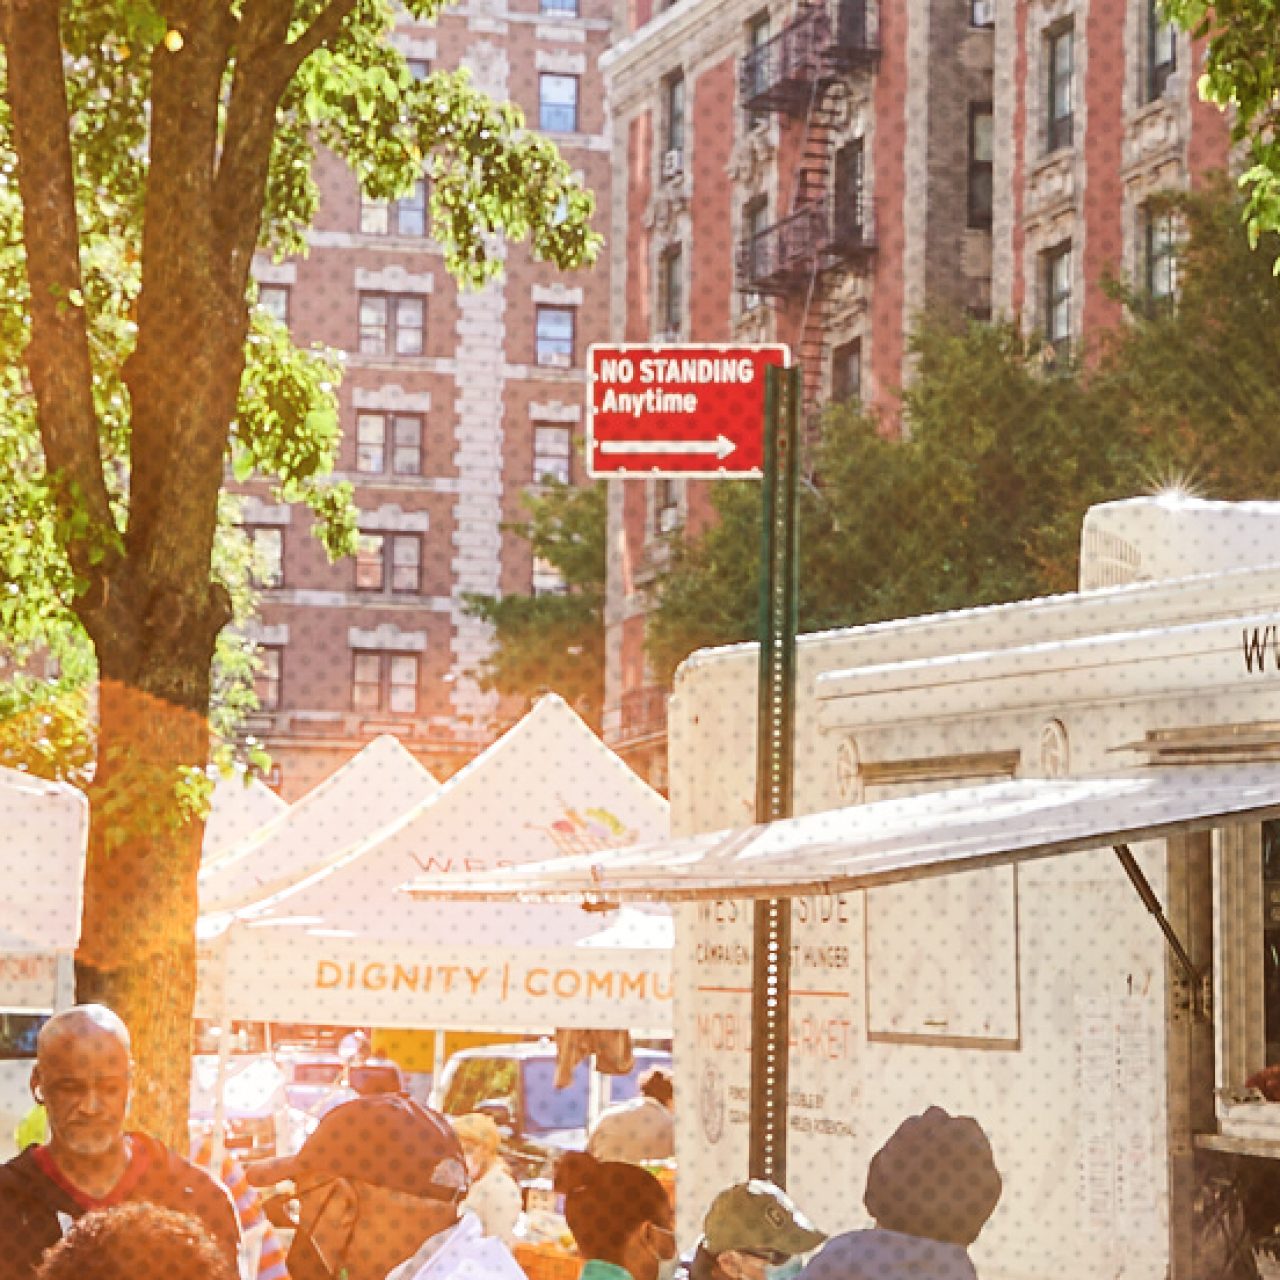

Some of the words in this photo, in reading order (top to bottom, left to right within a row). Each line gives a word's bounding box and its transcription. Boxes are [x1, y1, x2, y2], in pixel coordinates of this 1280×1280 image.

[601, 358, 634, 383] NO
[639, 358, 754, 383] STANDING
[602, 388, 698, 418] Anytime
[314, 959, 490, 993] DIGNITY
